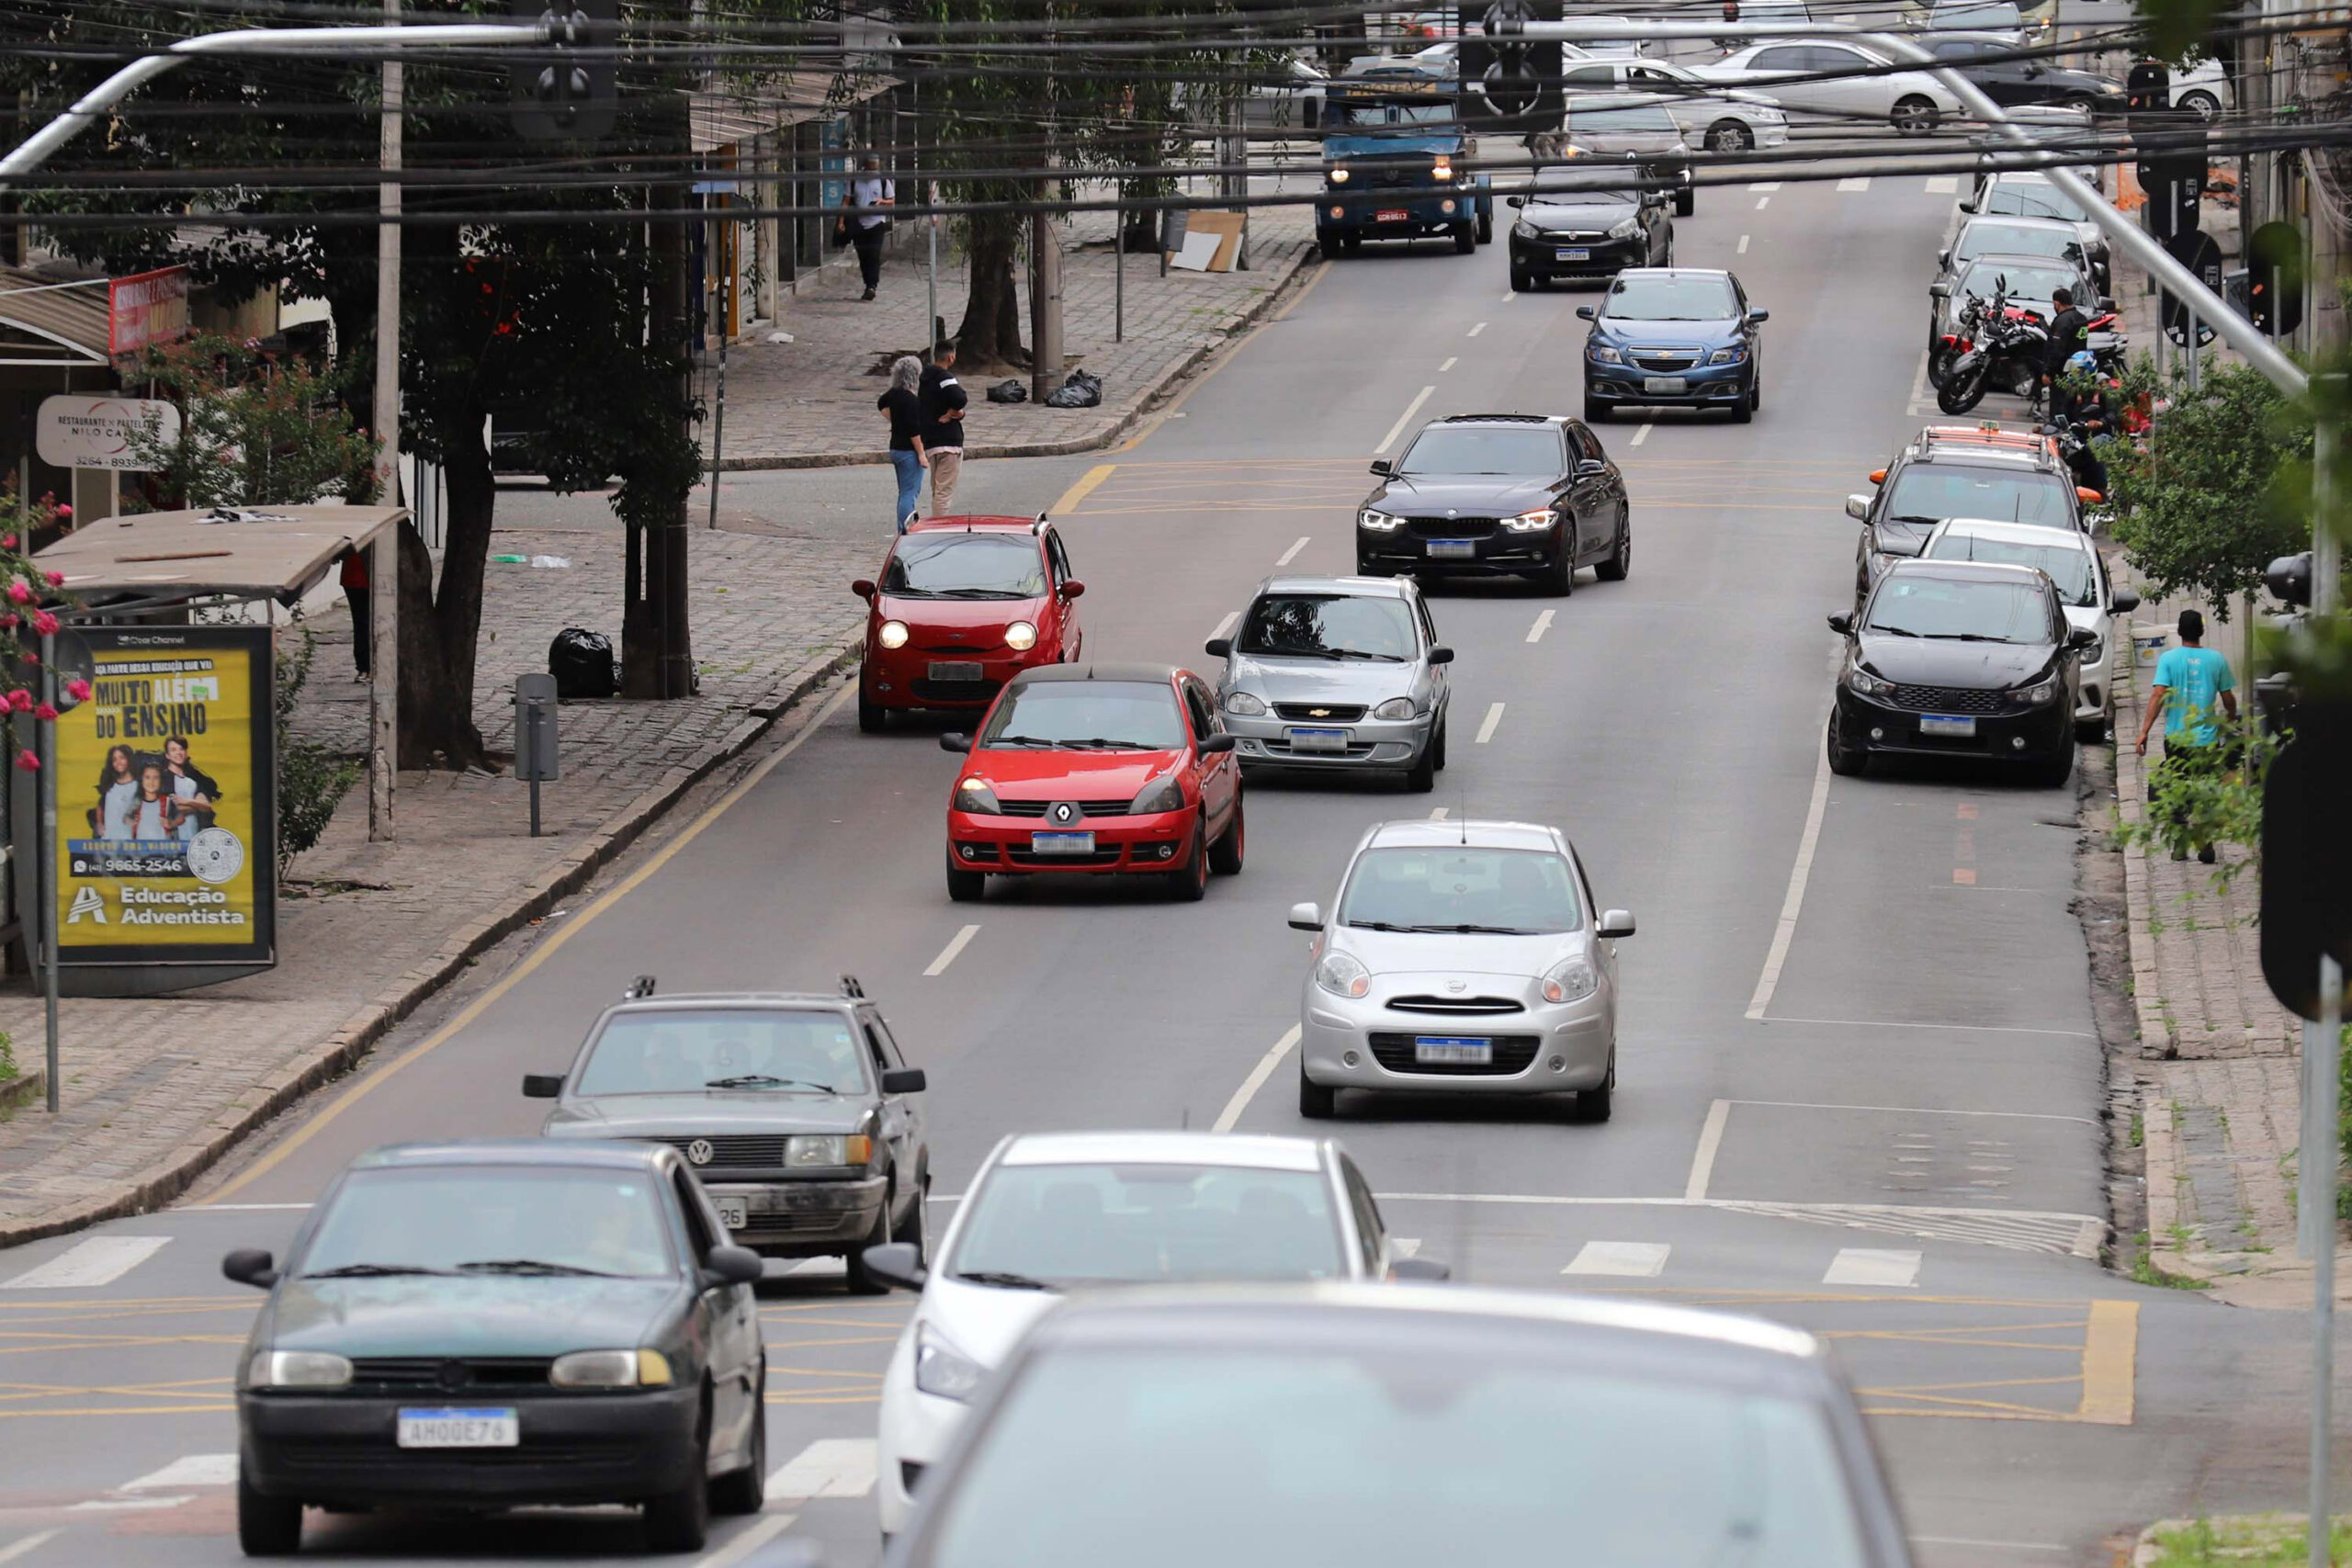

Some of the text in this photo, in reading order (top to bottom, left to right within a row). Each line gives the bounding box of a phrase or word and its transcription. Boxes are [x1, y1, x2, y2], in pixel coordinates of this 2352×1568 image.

[72, 427, 101, 436] NILO
[152, 635, 185, 645] Channel
[184, 660, 198, 671] QUE
[96, 672, 220, 705] MUITO ALÉM
[96, 703, 207, 739] DO ENSINO
[106, 860, 182, 872] 9665-2546
[121, 886, 226, 906] Educação
[121, 908, 245, 925] Adventista
